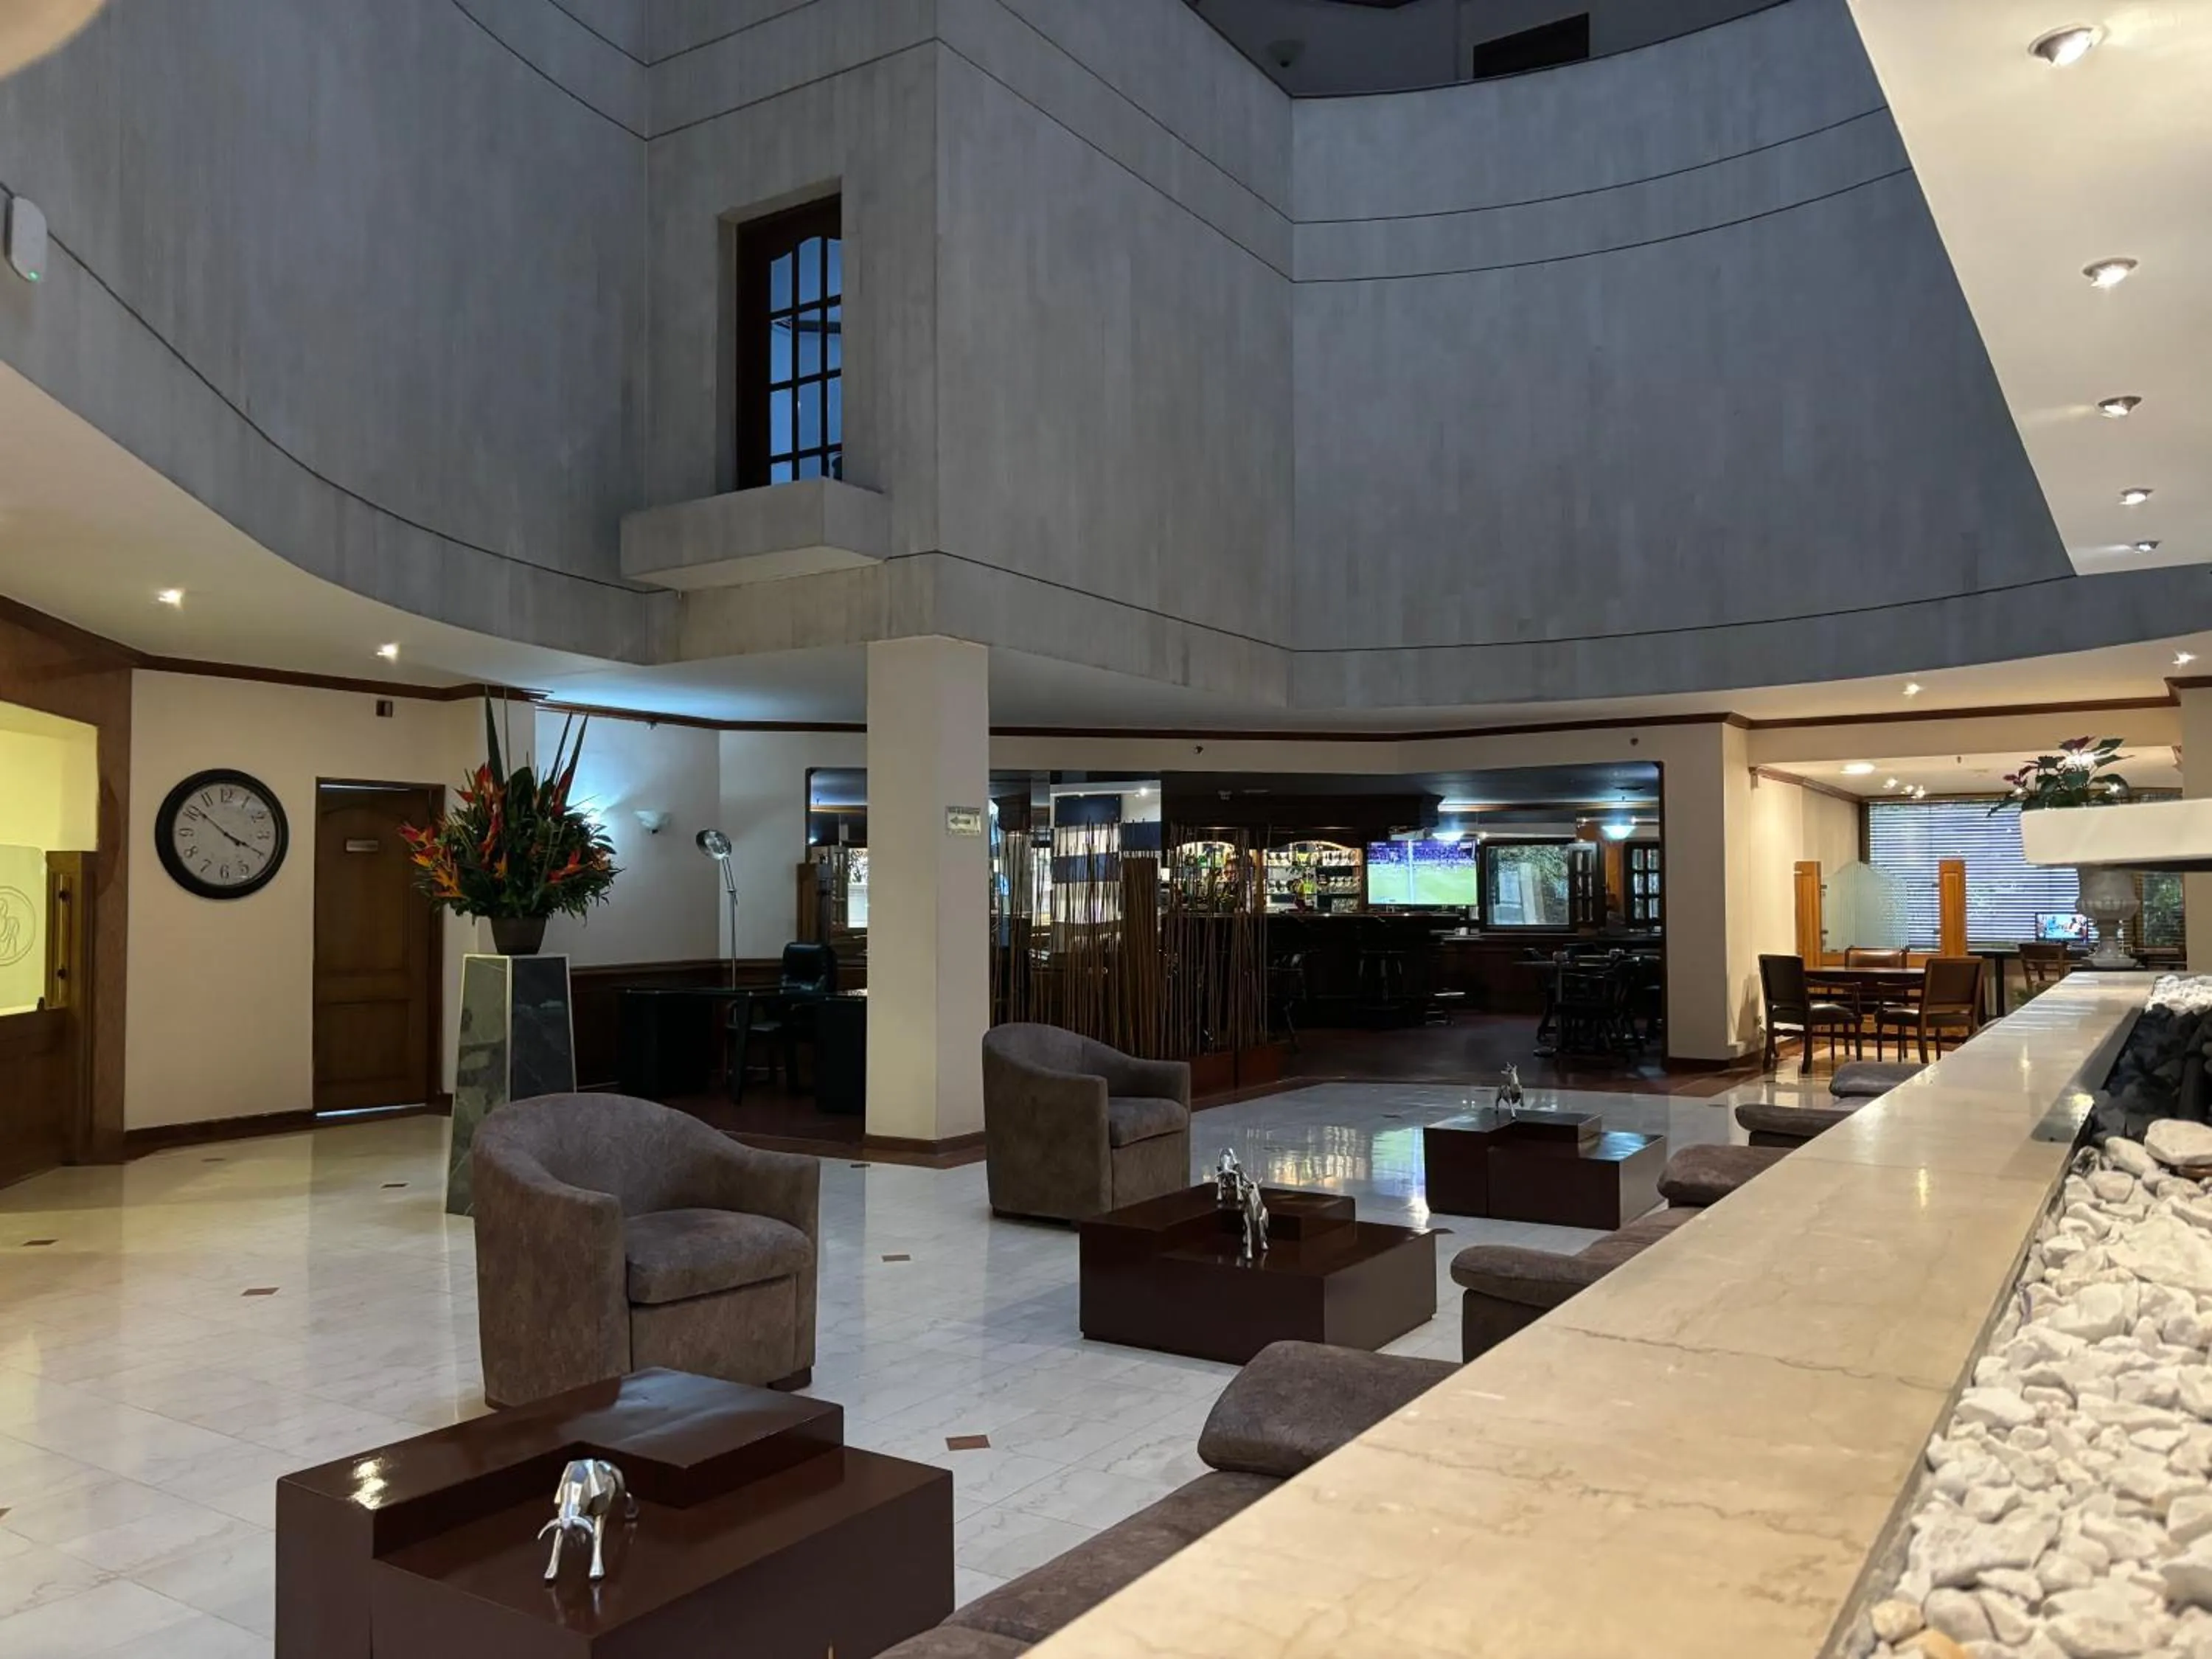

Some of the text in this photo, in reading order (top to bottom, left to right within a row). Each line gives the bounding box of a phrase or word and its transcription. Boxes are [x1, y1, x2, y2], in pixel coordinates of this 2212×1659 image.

[201, 792, 214, 807] 11
[220, 789, 234, 804] 12
[242, 796, 251, 809] 1
[183, 805, 201, 821] 10
[251, 811, 265, 824] 2
[178, 827, 194, 838] 9
[257, 830, 271, 840] 3
[184, 845, 199, 858] 8
[199, 859, 212, 873] 7
[220, 865, 230, 879] 6
[237, 860, 250, 874] 5
